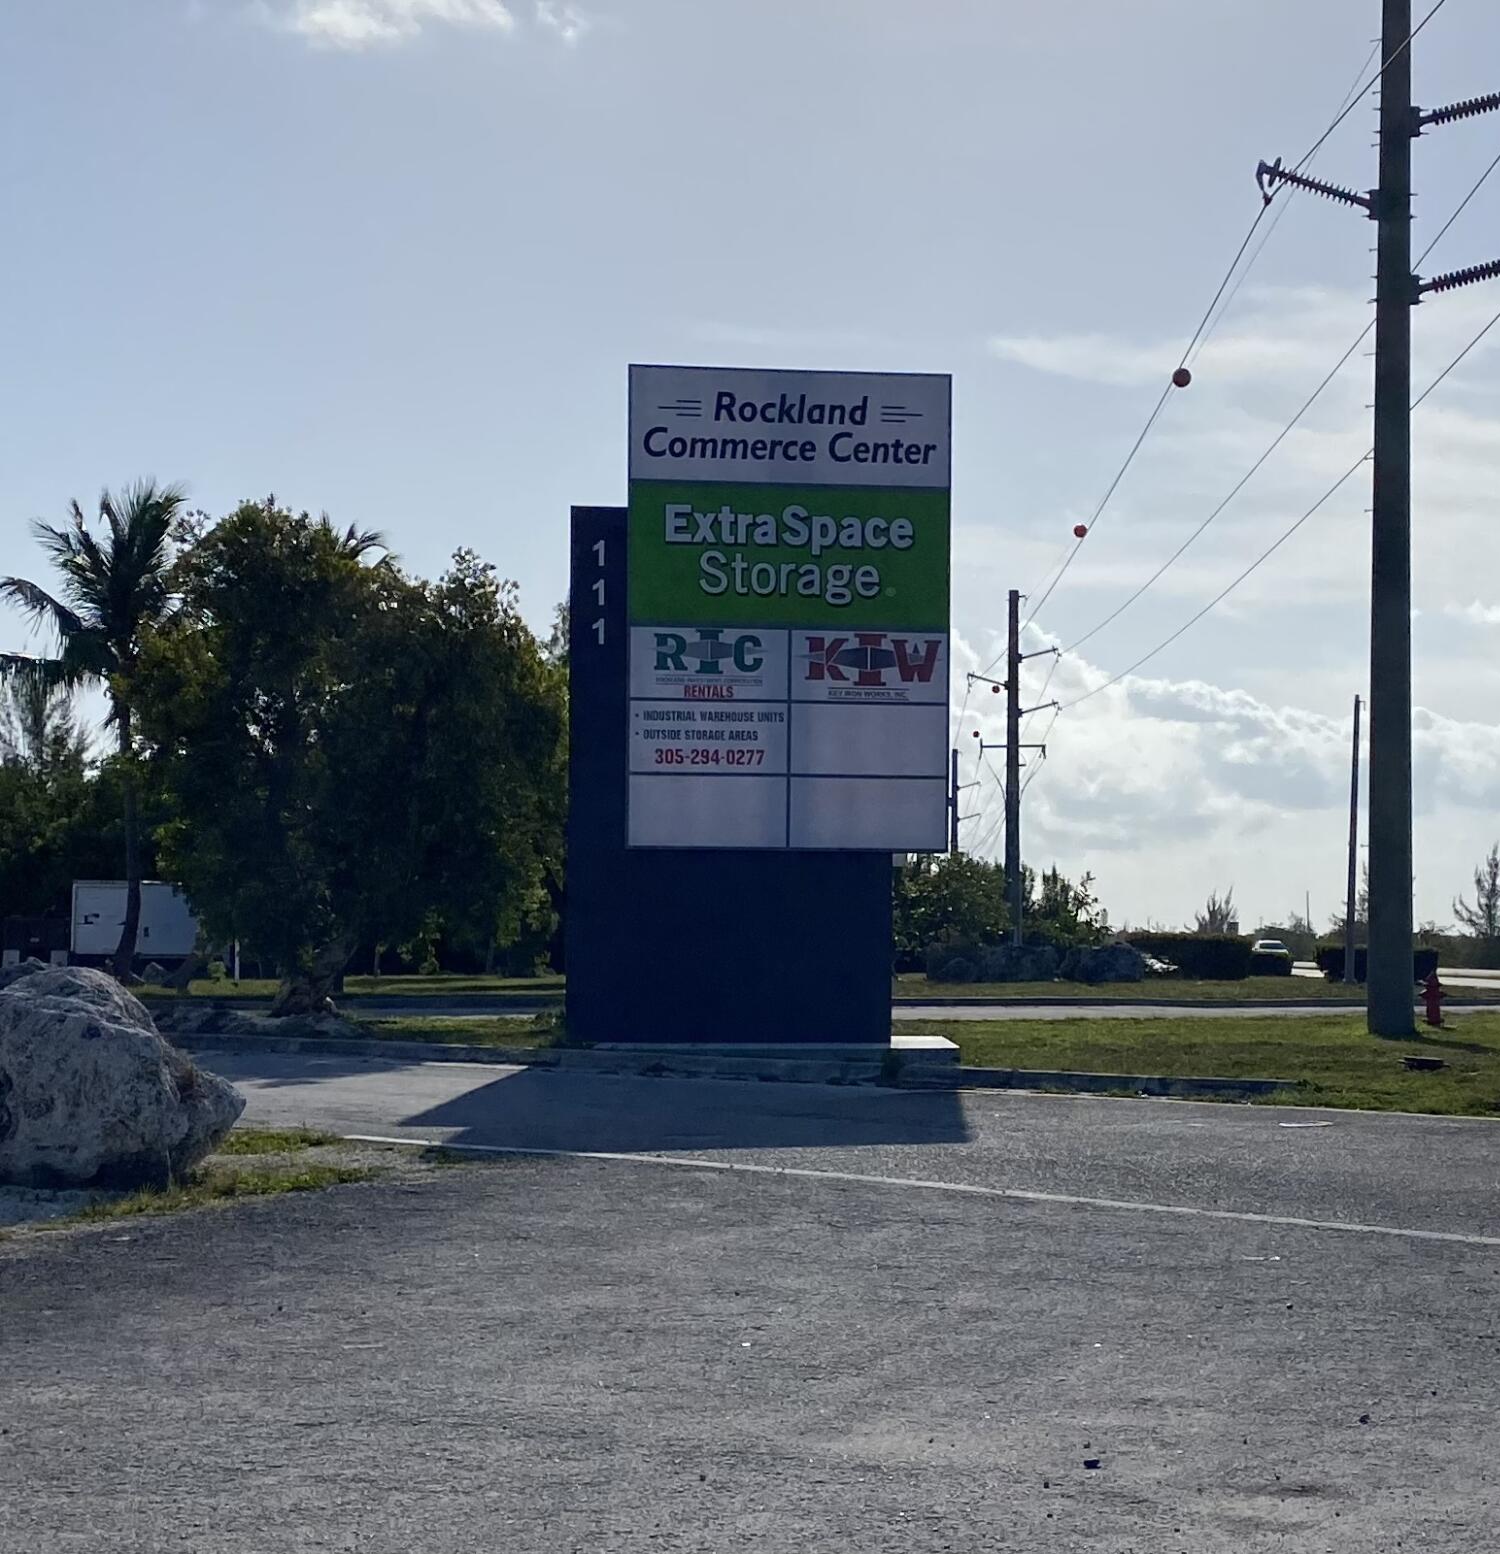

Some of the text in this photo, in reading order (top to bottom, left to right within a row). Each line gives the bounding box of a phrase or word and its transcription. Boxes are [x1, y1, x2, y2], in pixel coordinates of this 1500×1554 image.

[714, 391, 868, 426] Rockland
[643, 426, 937, 465] Commerce Center
[699, 550, 881, 605] Storage
[684, 684, 734, 698] RENTALS
[643, 710, 785, 723] INDUSTRIAL WAREHOUSE UNITS
[643, 729, 759, 741] OUTSIDE STORAGE AREAS
[655, 749, 766, 765] 305-294-0277
